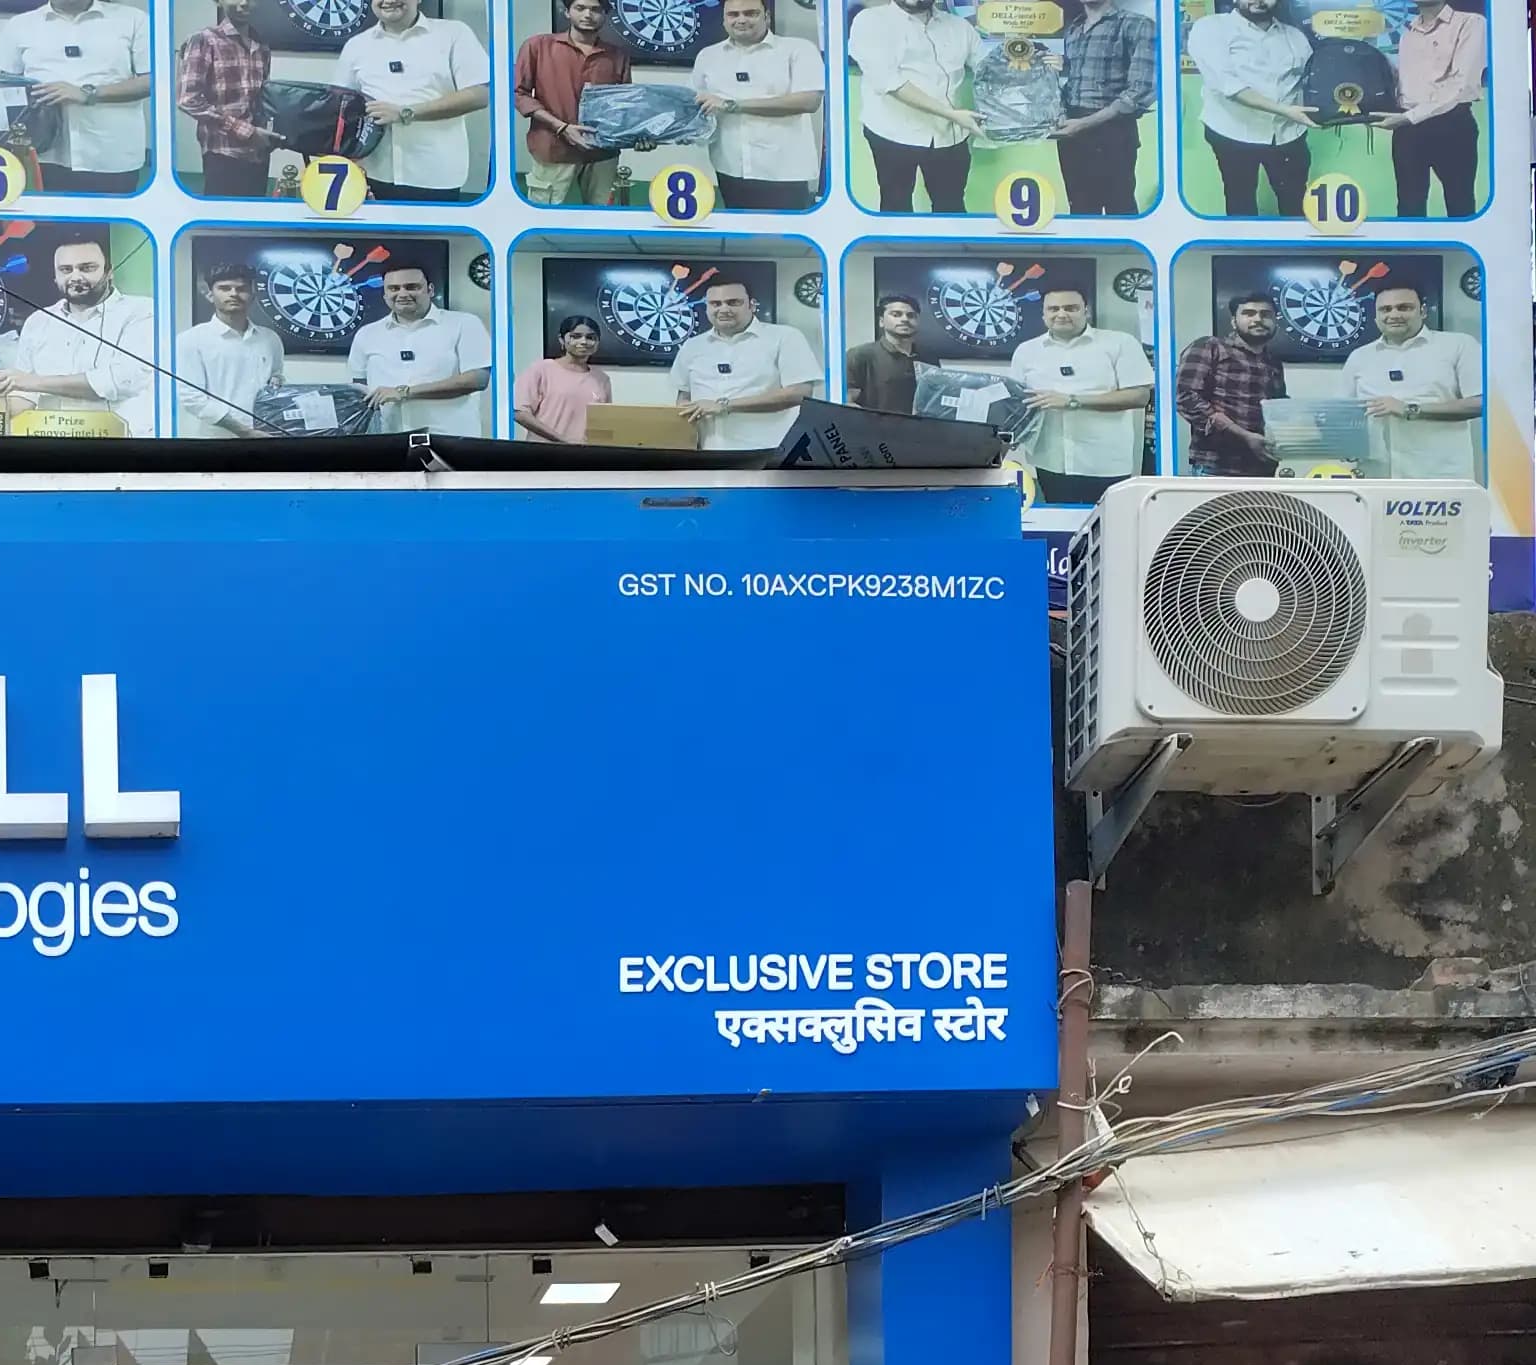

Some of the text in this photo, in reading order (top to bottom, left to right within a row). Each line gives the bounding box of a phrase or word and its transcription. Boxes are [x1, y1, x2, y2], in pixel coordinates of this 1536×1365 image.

[318, 163, 349, 212] 7
[665, 173, 697, 221] 8
[1009, 178, 1041, 228] 9
[1310, 183, 1360, 223] 10
[58, 415, 86, 426] Prize
[1386, 500, 1462, 516] VOLTAS
[618, 573, 1005, 600] GST NO. 10AXCPK9238M1ZC
[619, 951, 1008, 993] EXCLUSIVE STORE
[715, 995, 1010, 1056] एक्सक्लुसिव स्टोर
